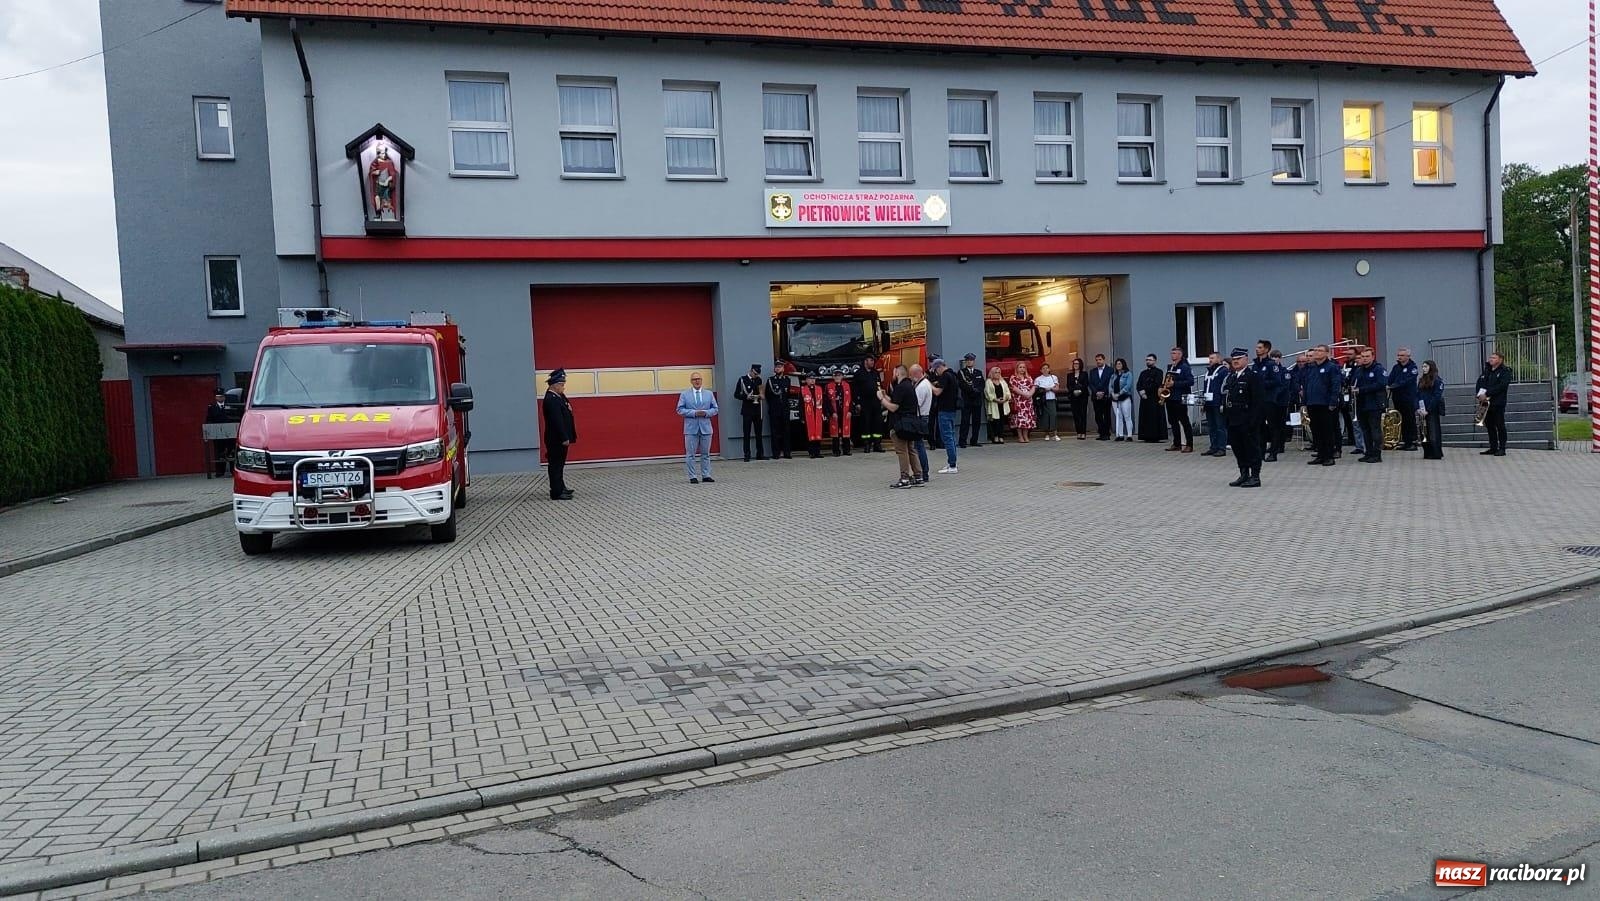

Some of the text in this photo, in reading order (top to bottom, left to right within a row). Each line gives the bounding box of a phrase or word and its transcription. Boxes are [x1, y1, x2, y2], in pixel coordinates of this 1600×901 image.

[803, 193, 854, 201] OCHOTNICZA
[798, 205, 921, 222] PIETROWICE WIELKIE
[317, 461, 356, 470] MAN
[309, 472, 361, 484] SRC YT26
